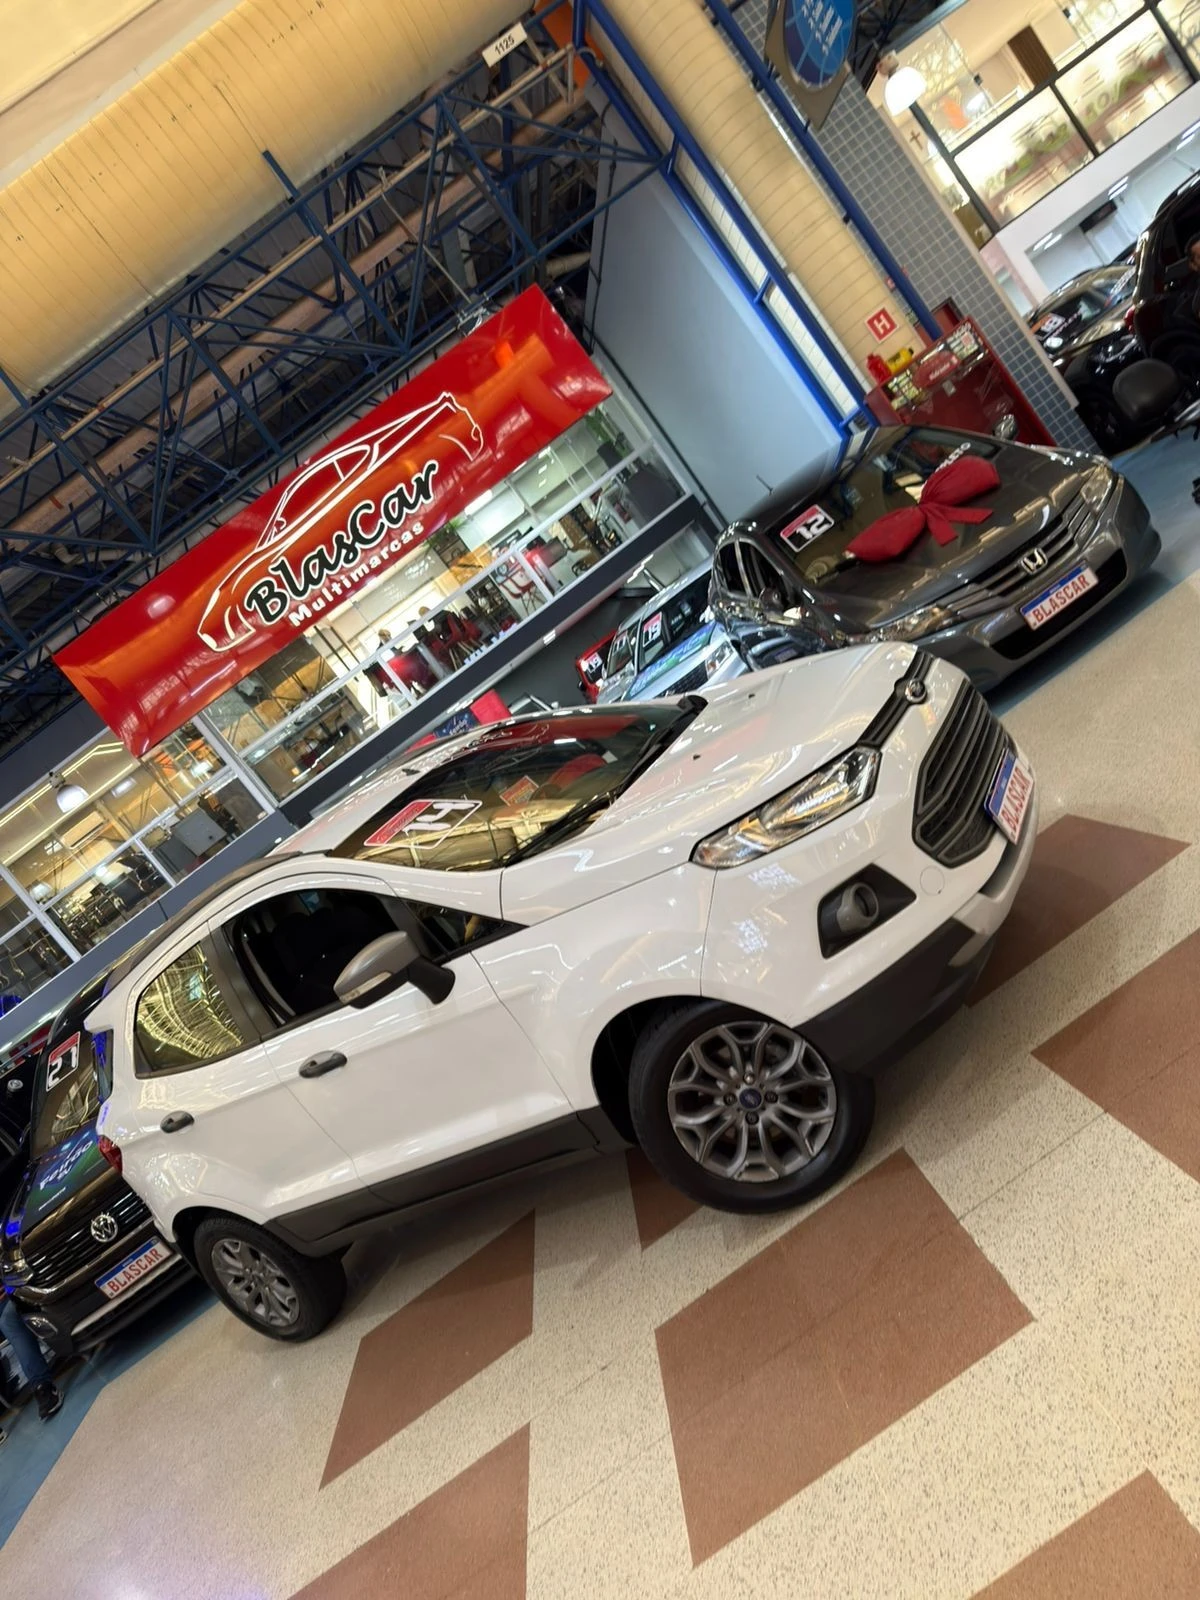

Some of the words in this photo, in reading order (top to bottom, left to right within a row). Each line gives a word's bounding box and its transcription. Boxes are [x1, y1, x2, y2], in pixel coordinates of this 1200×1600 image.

[494, 33, 515, 55] 1125
[244, 460, 439, 625] BlasCar
[796, 513, 831, 540] 12
[288, 522, 424, 627] Multimarcas
[1032, 574, 1090, 624] BLASCAR
[647, 624, 660, 638] 19
[401, 803, 475, 836] 14
[1001, 766, 1031, 832] BLASCAR
[48, 1046, 77, 1087] 21
[107, 1248, 163, 1293] BLASCAR
